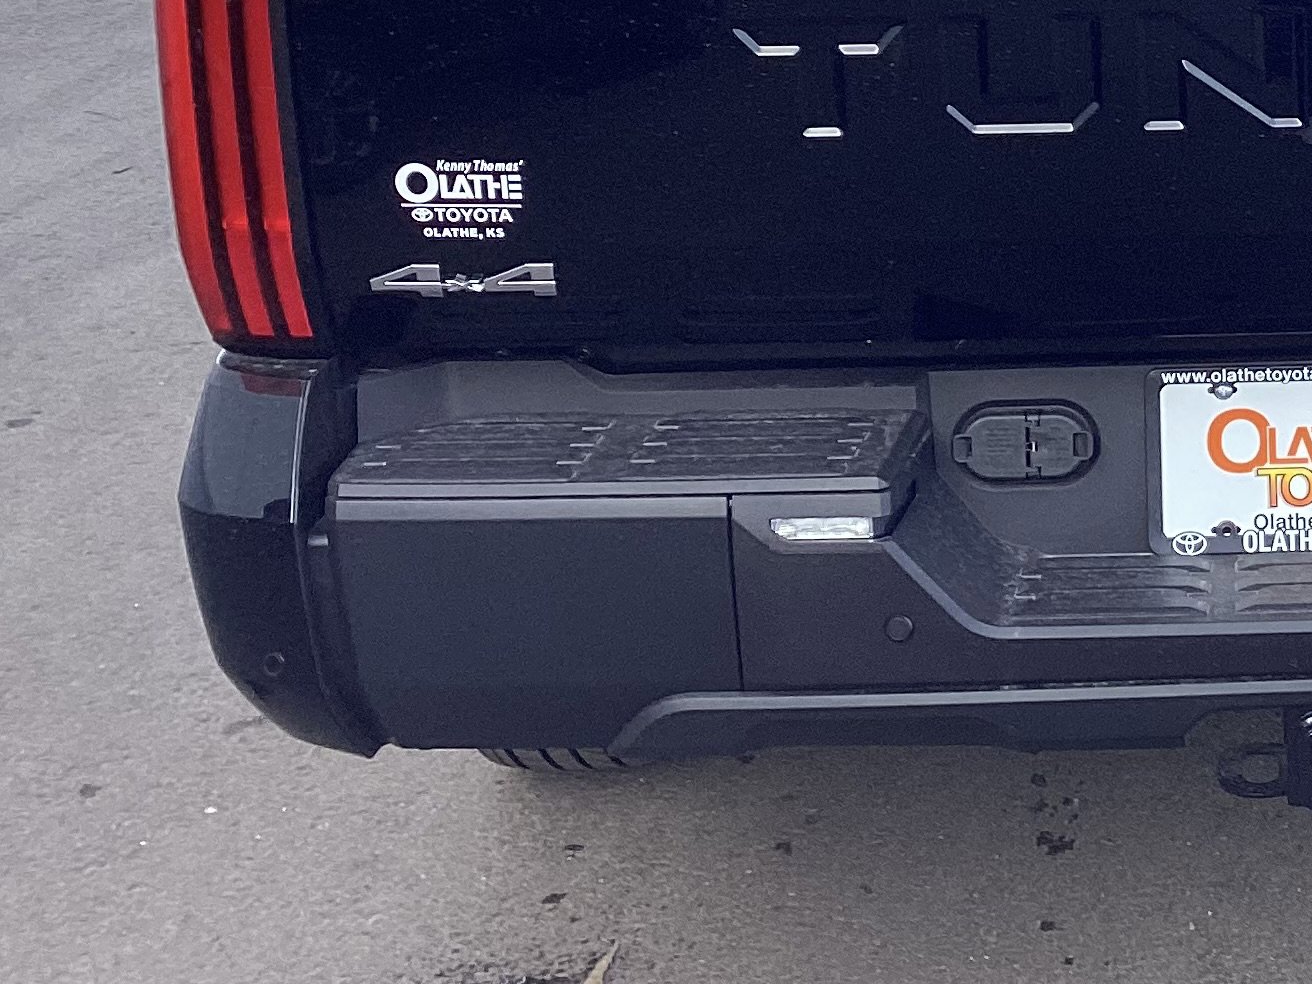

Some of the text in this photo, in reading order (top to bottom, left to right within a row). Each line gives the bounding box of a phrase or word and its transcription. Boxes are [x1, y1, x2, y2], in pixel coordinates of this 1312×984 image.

[436, 159, 471, 173] Kenny
[395, 162, 523, 203] OLATHE
[434, 208, 514, 223] TOYOTA
[424, 227, 505, 240] OLATHE, KS
